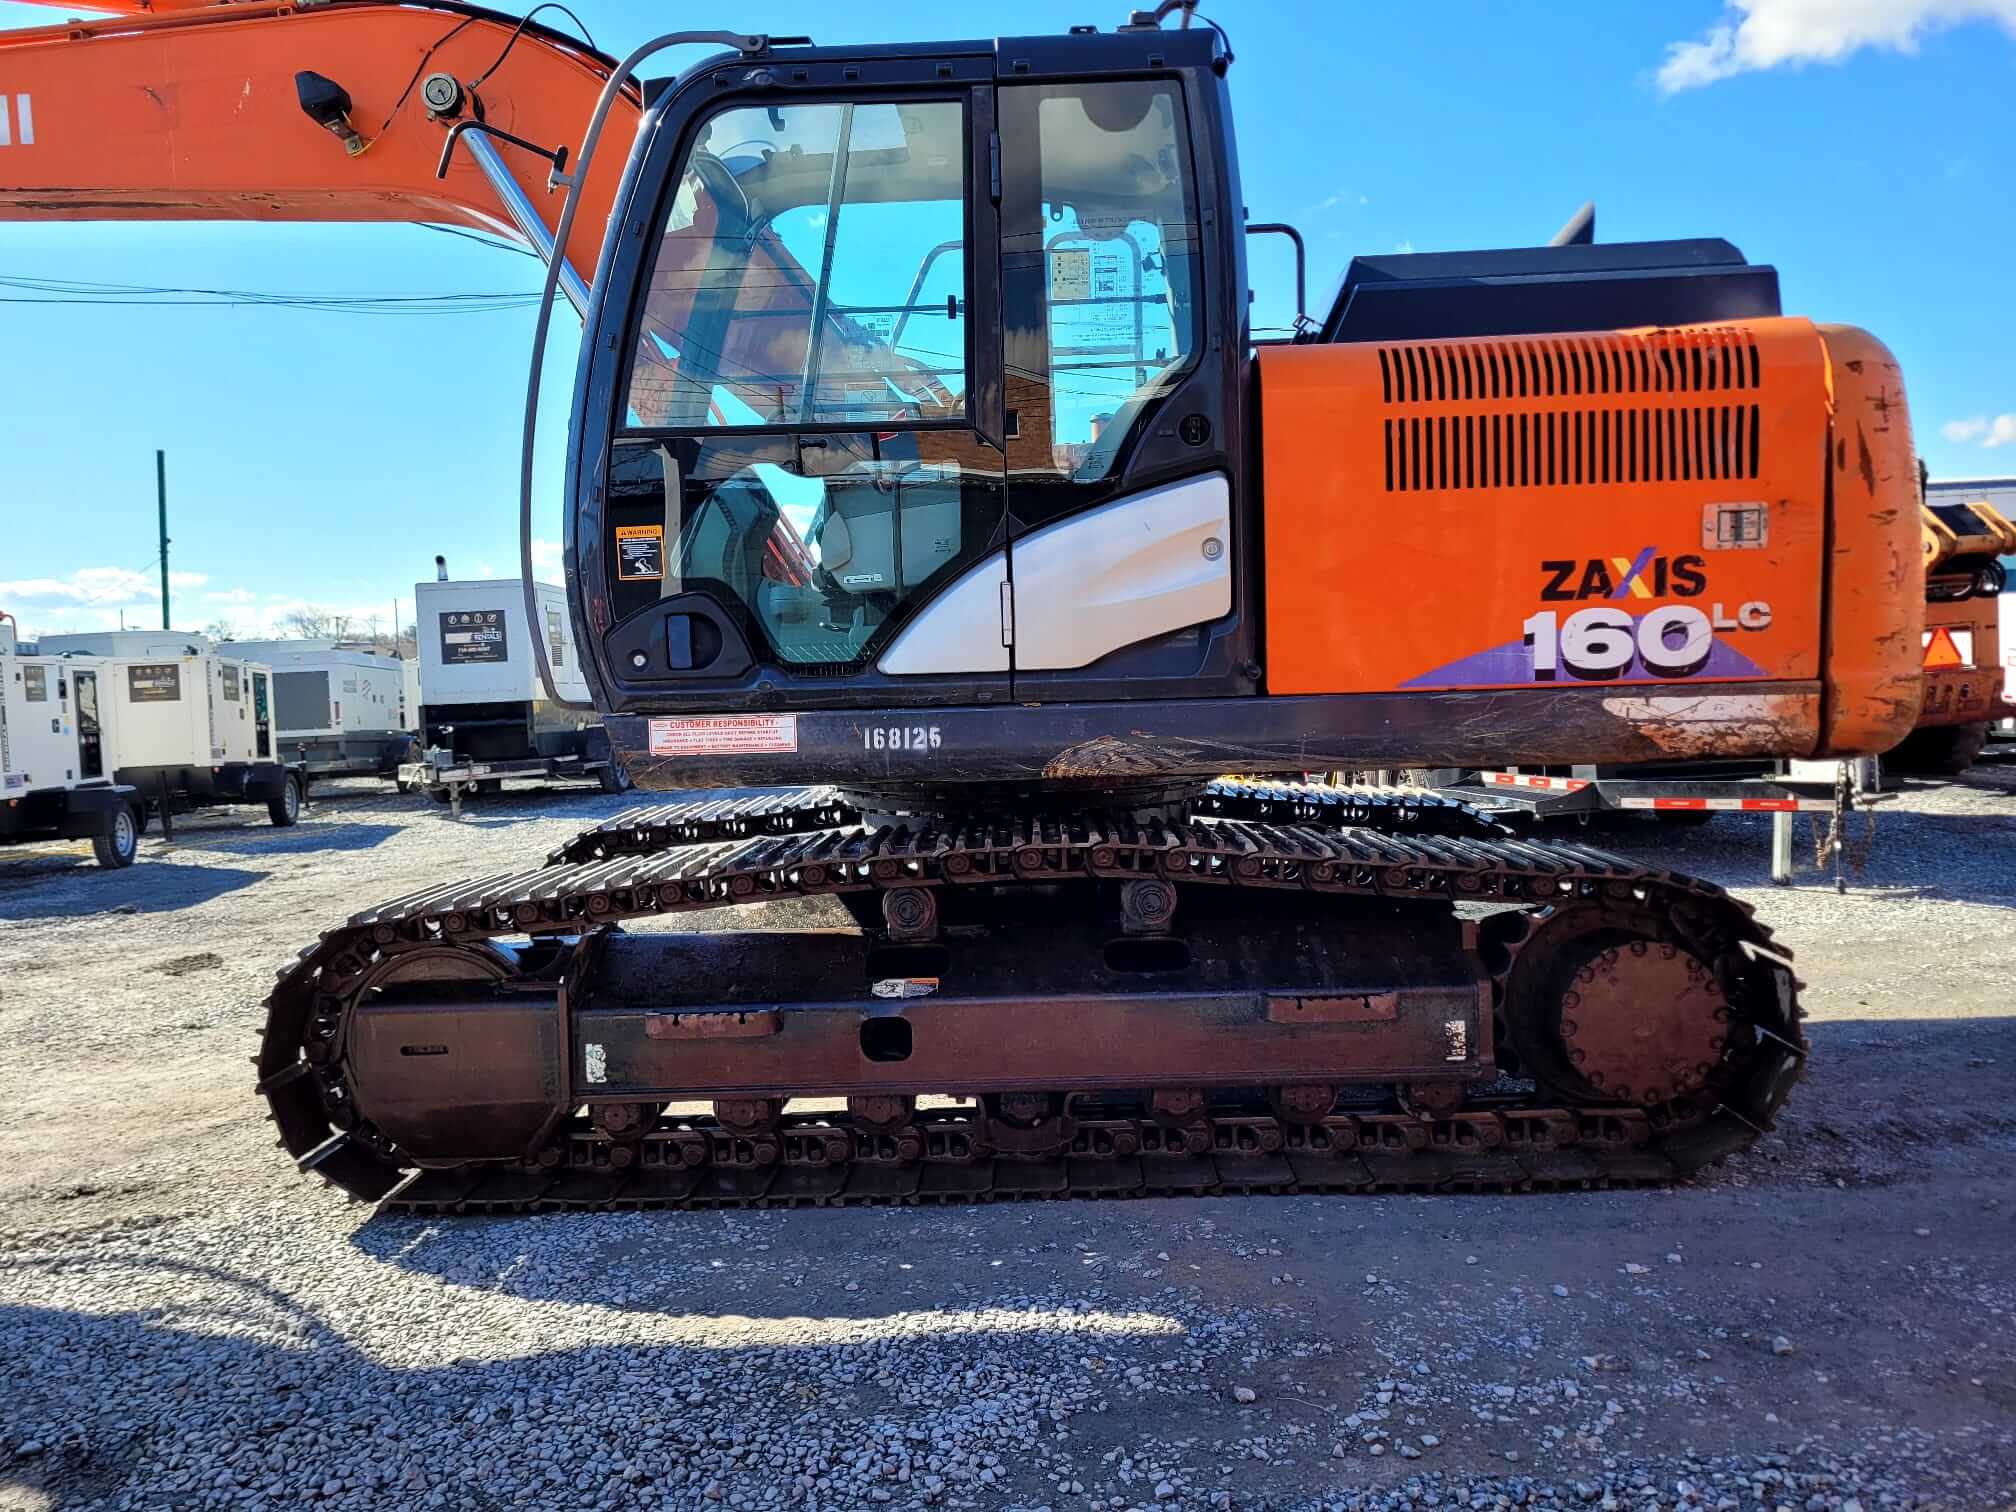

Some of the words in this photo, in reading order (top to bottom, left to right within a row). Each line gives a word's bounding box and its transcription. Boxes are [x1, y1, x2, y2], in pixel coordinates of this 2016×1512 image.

[1541, 547, 1708, 601] ZAXIS
[1523, 604, 1714, 681] 160
[1712, 601, 1773, 632] LC
[670, 720, 711, 729] CUSTOMER
[713, 719, 775, 728] RESPONSIBILITY
